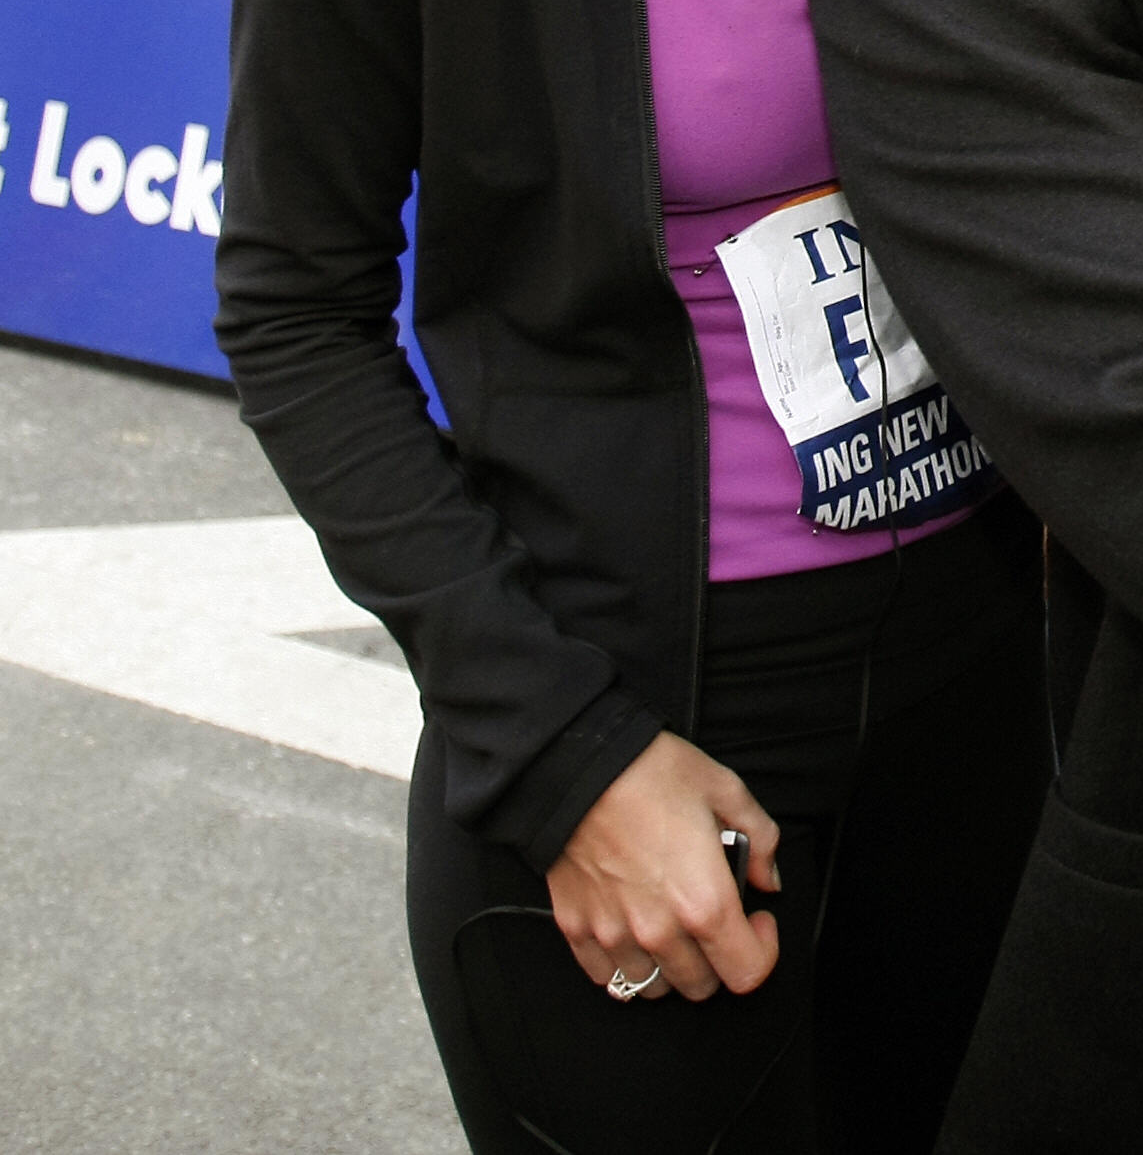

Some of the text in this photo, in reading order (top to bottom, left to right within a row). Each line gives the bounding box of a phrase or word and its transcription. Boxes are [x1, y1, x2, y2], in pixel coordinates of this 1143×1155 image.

[30, 98, 223, 237] Lock
[813, 395, 948, 493] ING NEW
[814, 435, 992, 530] MARATHON
